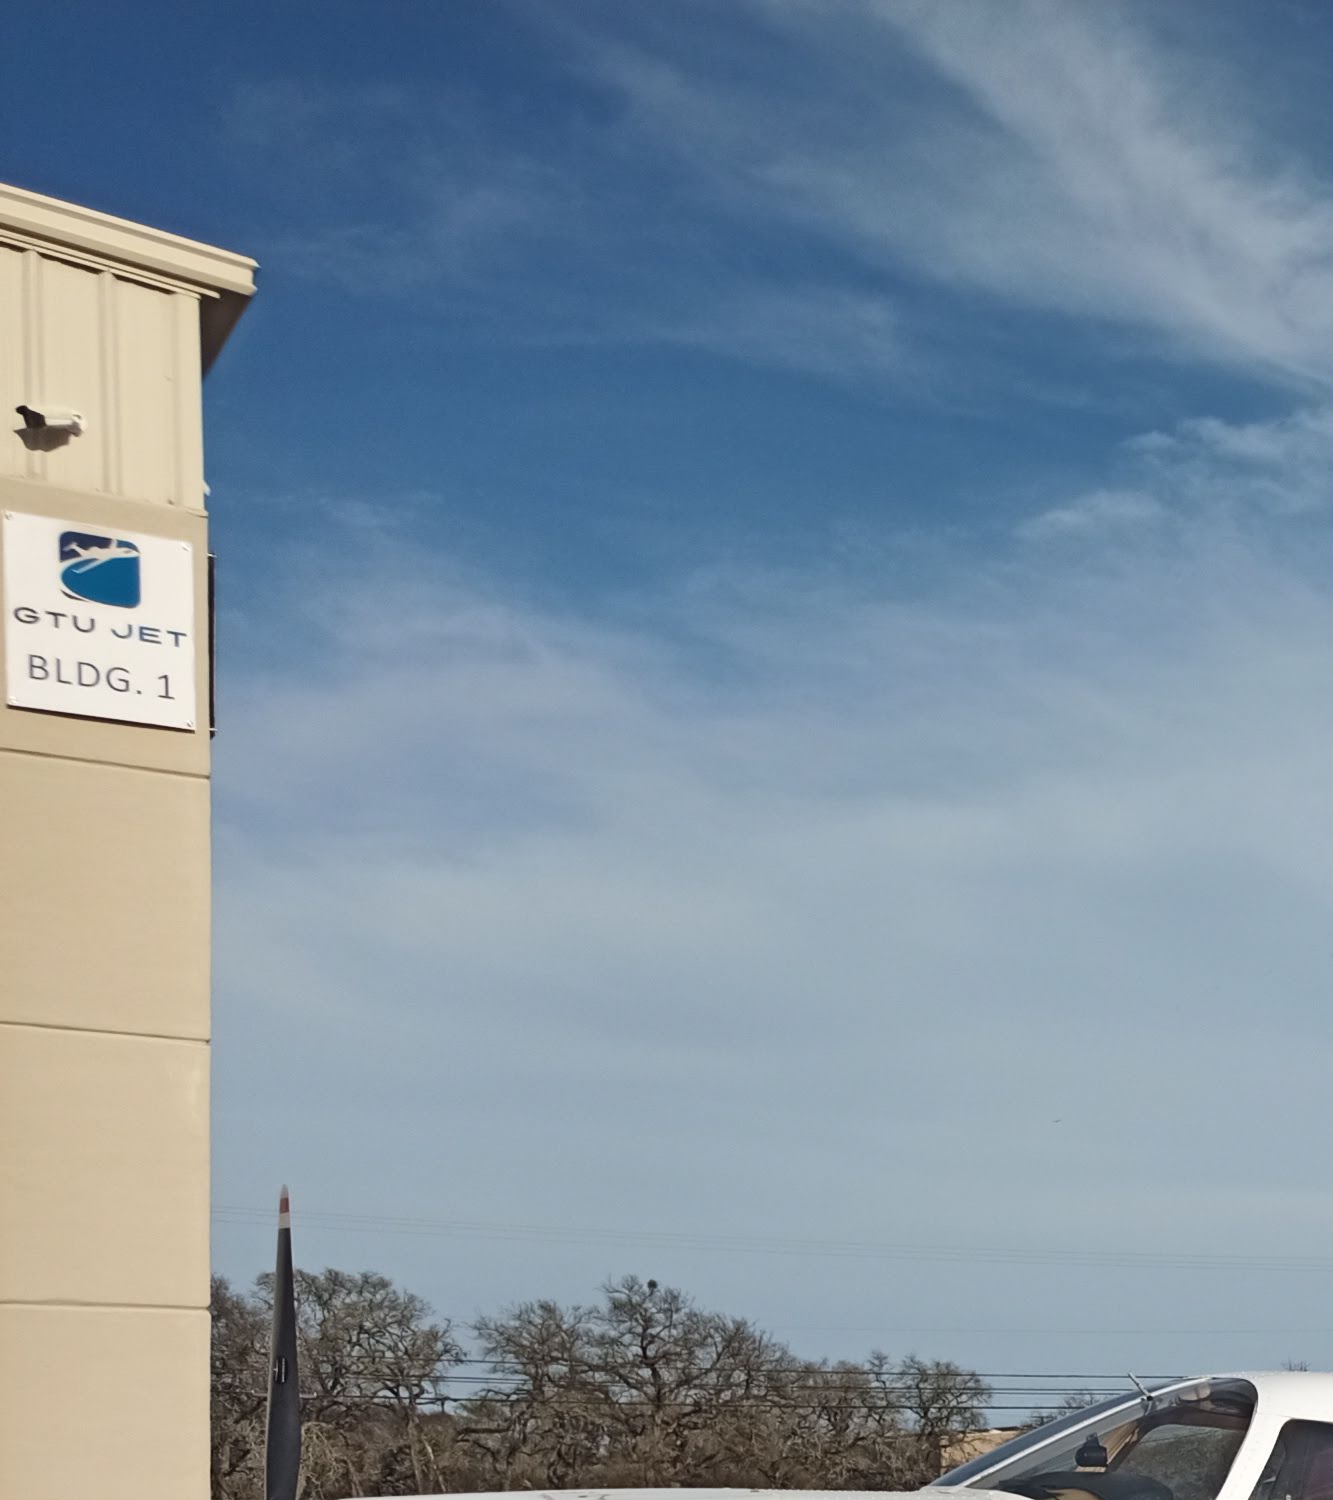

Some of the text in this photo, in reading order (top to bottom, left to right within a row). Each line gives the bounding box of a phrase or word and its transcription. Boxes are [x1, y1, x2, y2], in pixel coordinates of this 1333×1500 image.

[13, 606, 187, 647] GTU JET
[28, 654, 175, 700] BLDG. 1
